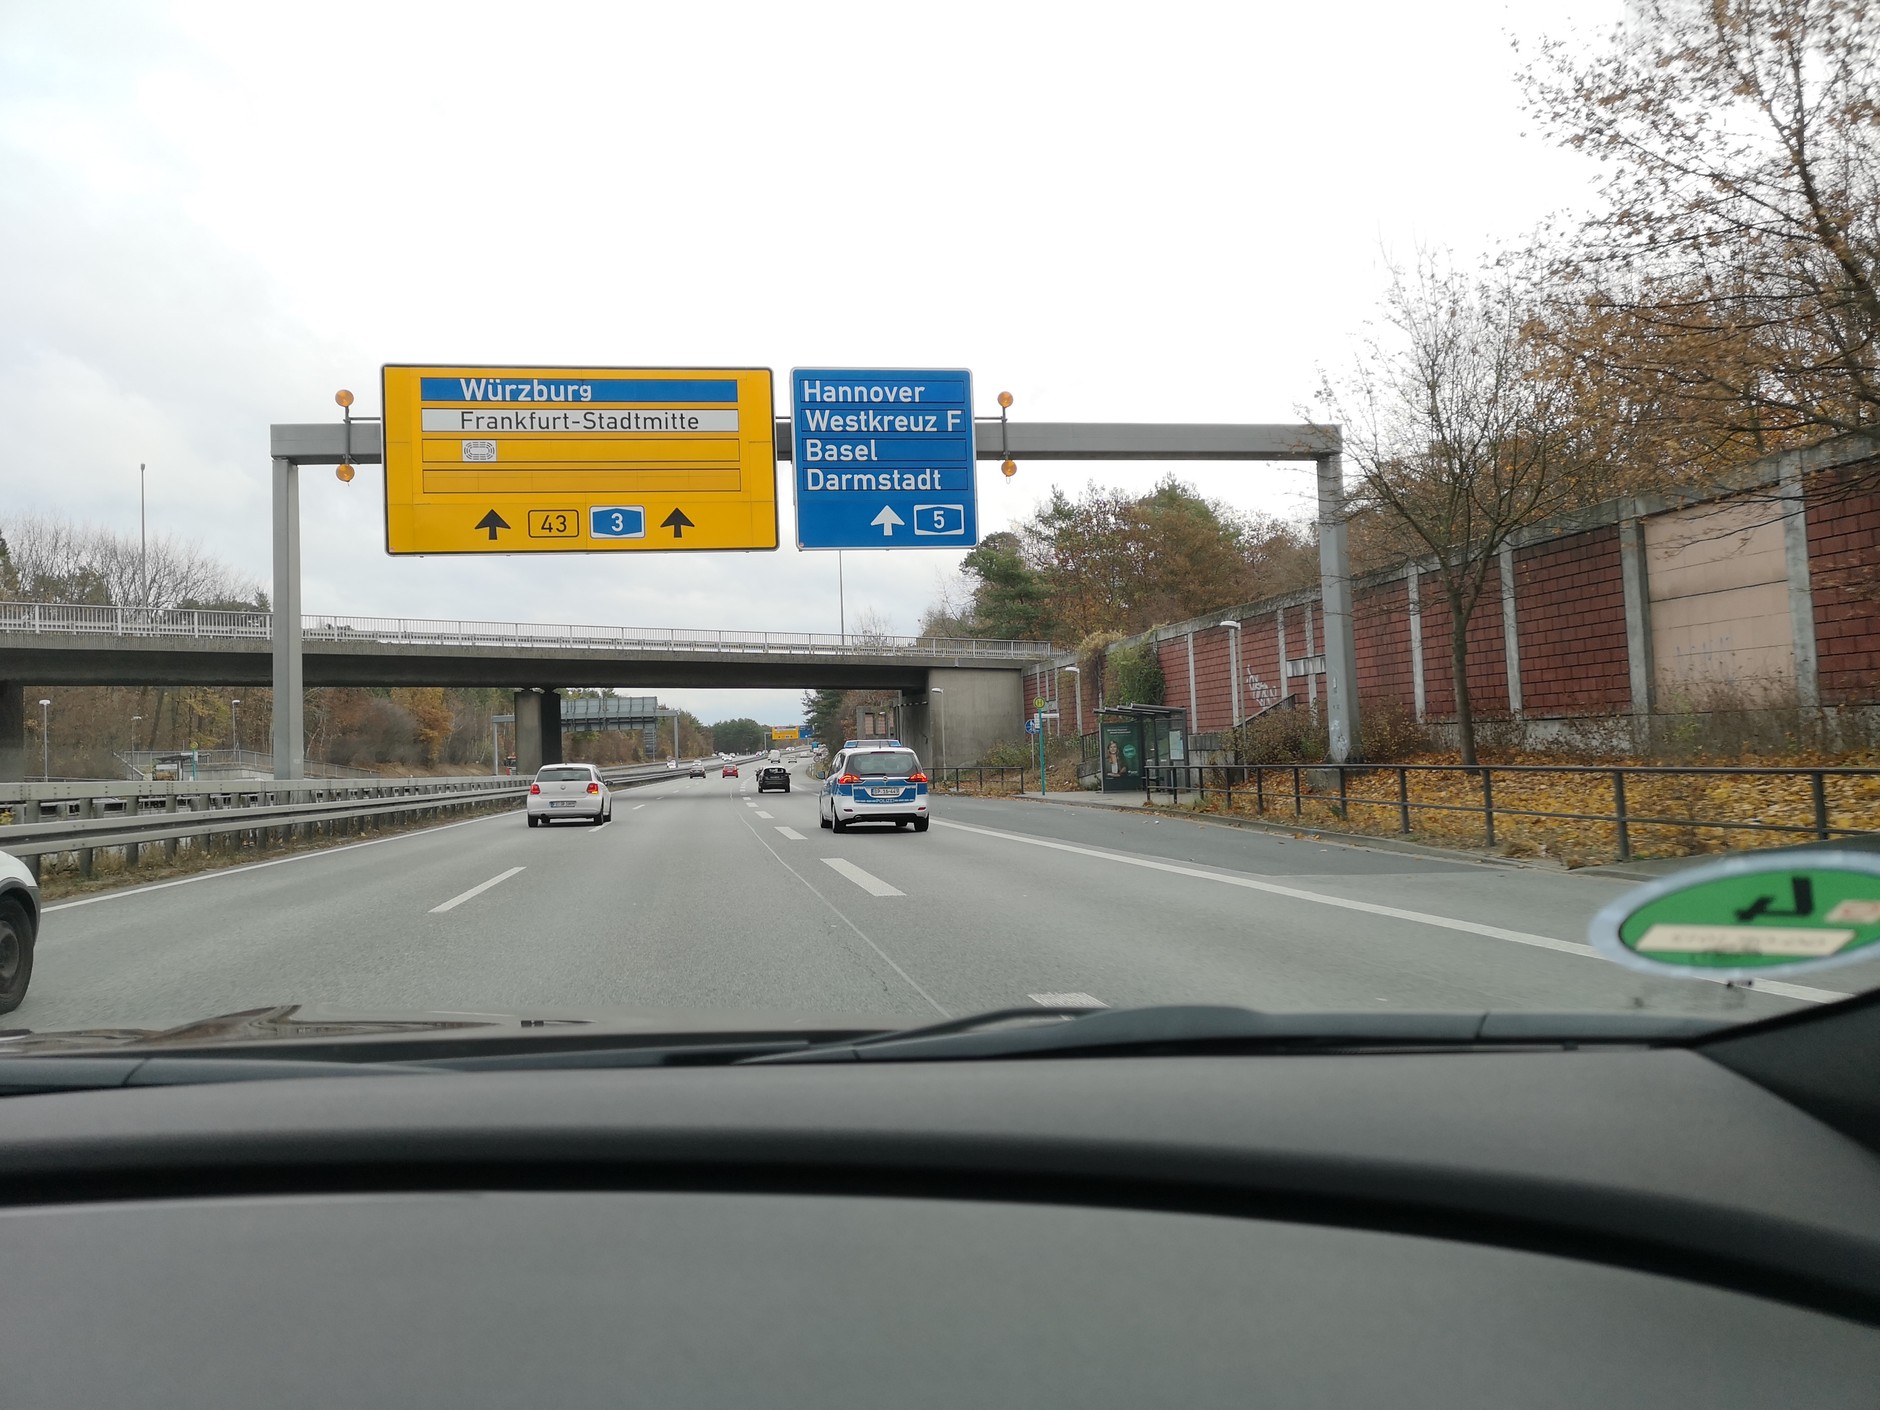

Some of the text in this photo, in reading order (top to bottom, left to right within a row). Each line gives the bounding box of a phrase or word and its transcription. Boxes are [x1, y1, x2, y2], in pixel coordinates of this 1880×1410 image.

[460, 378, 592, 402] Würzburg
[803, 380, 926, 403] Hannover
[460, 411, 700, 430] Frankfurt-Stadtmitte
[805, 409, 962, 432] Westkreuz F
[806, 439, 878, 461] Basel
[807, 468, 942, 491] Darmstadt
[540, 514, 568, 533] 43
[611, 512, 624, 532] 3
[933, 510, 945, 529] 5
